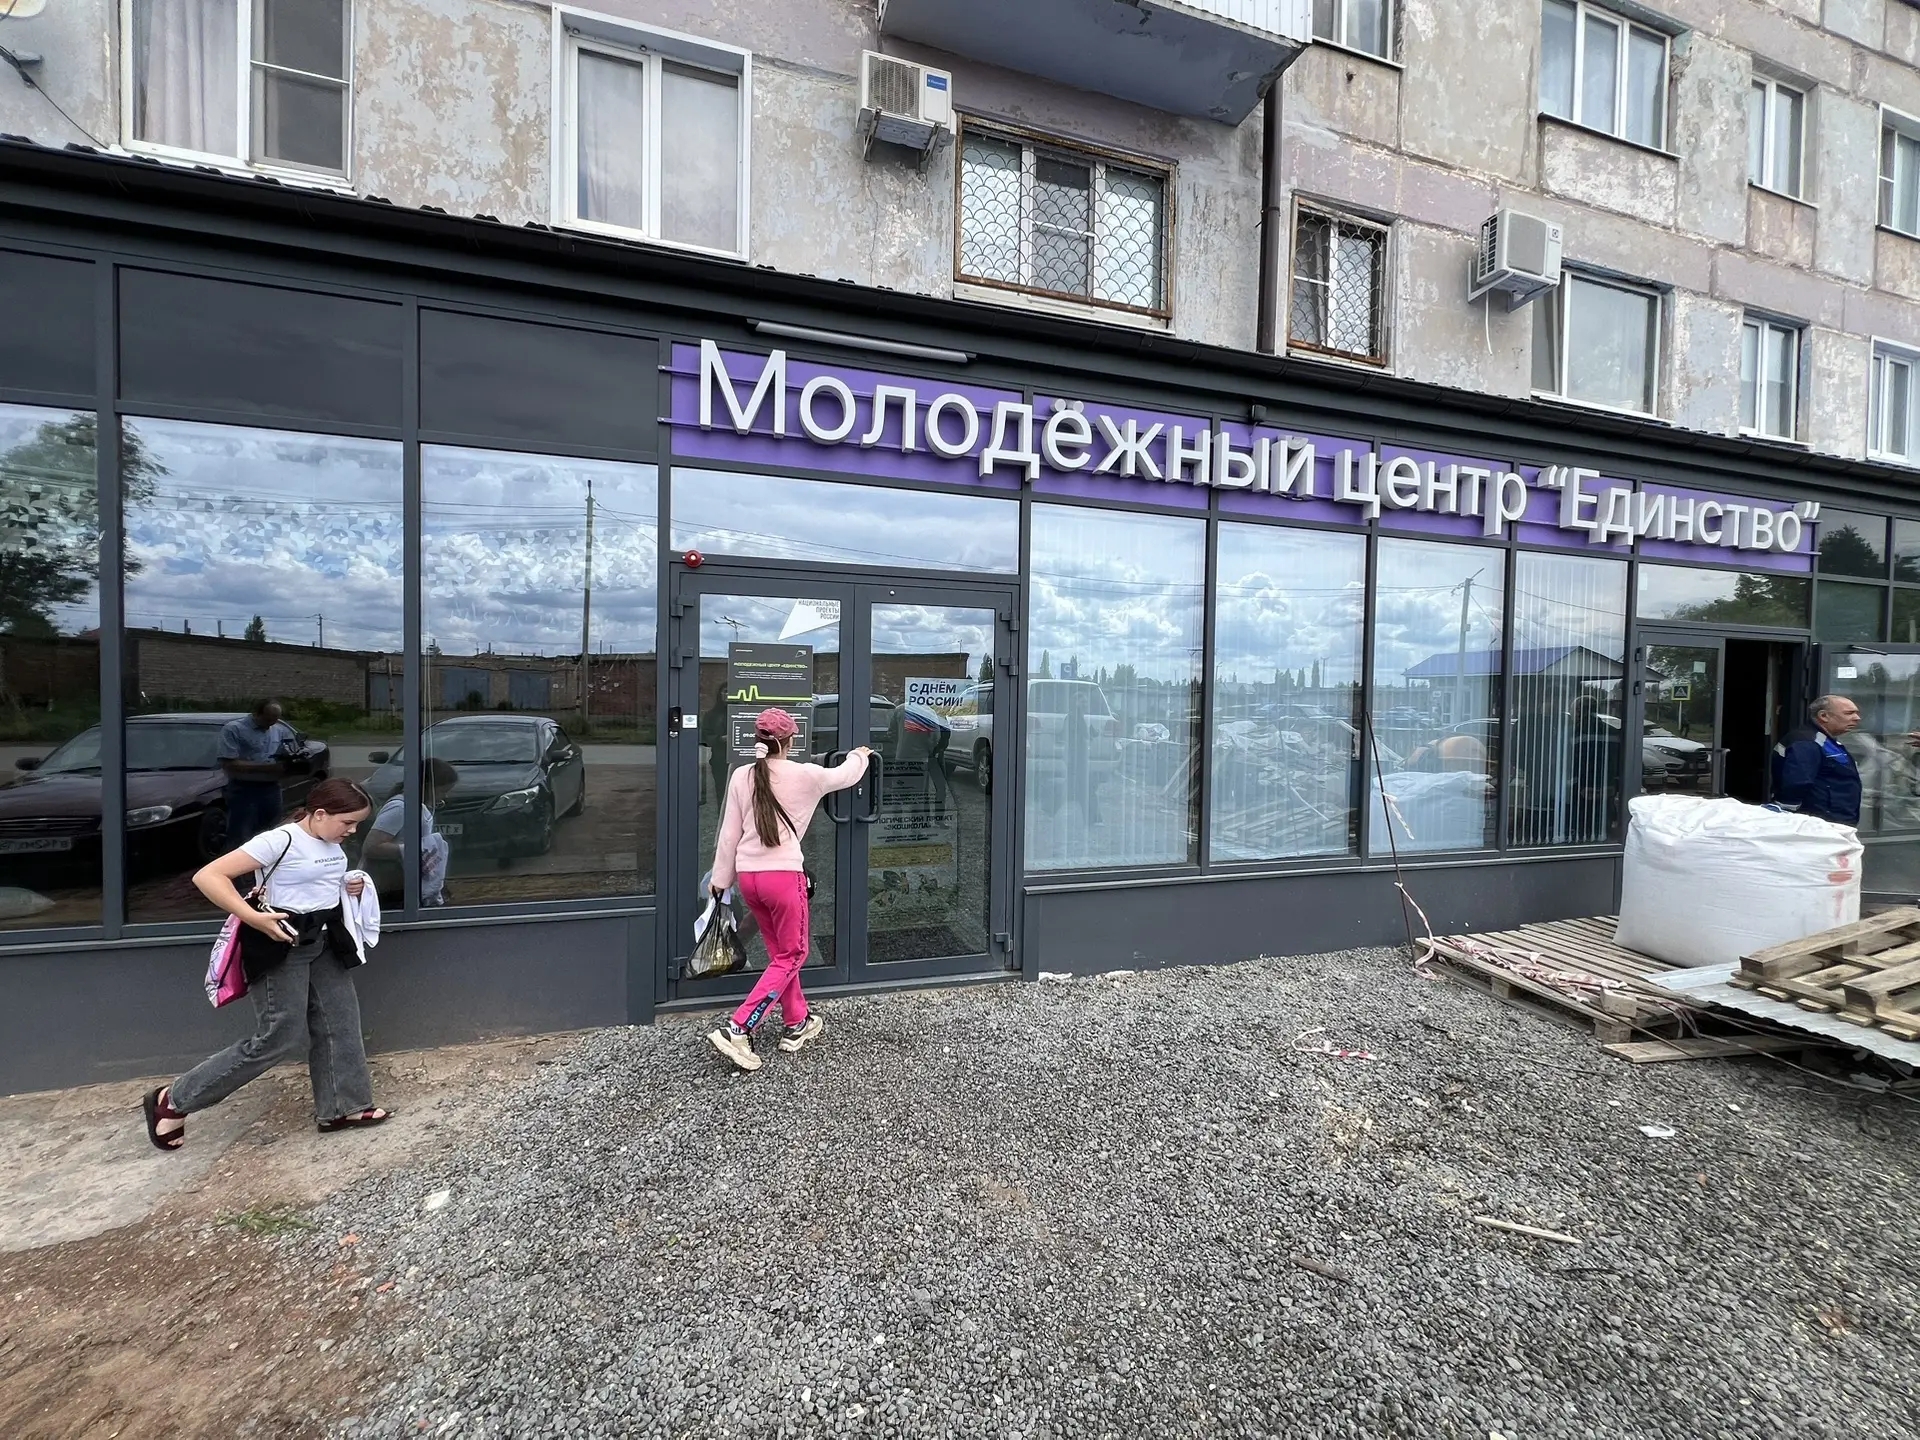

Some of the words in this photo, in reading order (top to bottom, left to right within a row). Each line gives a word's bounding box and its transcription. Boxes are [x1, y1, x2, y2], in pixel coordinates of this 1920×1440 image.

[700, 338, 1316, 497] Молодёжный
[1333, 449, 1528, 536] центр
[798, 600, 840, 608] НАЦИОНАЛЬНЫЕ
[909, 682, 918, 693] С
[920, 681, 957, 695] ДНЁМ
[908, 696, 964, 707] РОССИИ!
